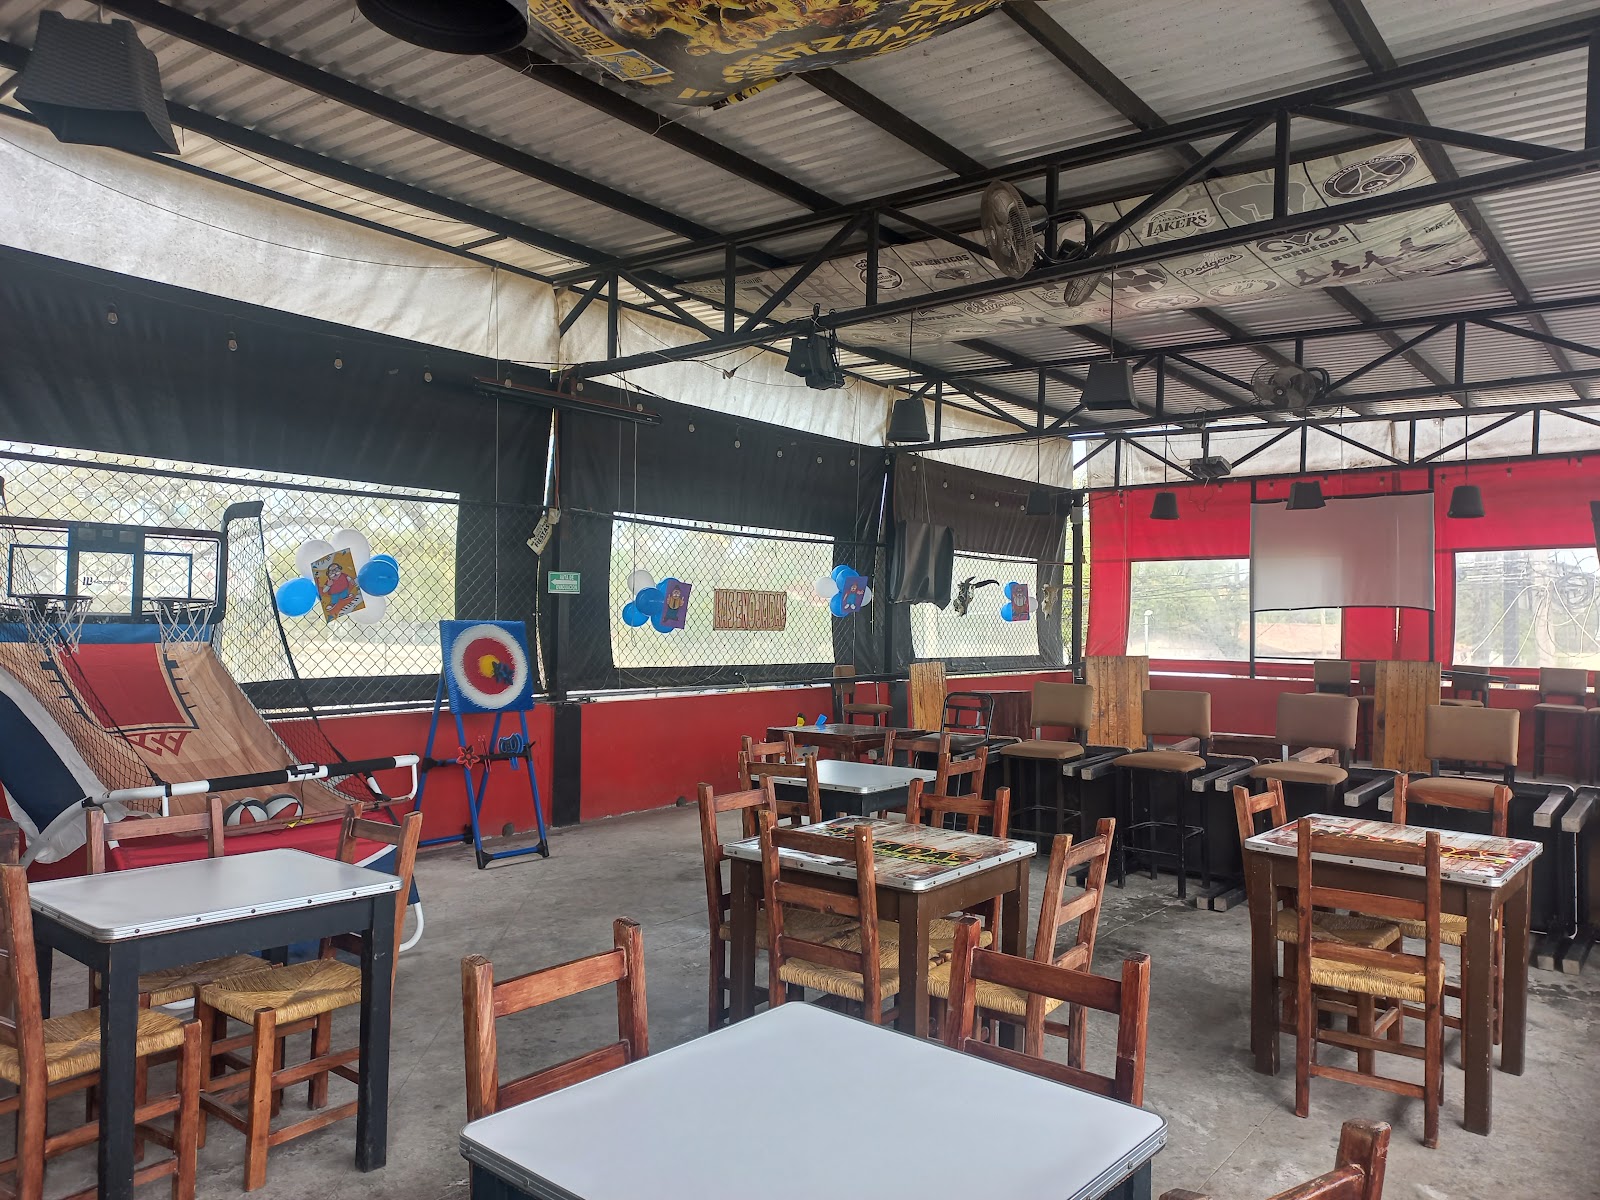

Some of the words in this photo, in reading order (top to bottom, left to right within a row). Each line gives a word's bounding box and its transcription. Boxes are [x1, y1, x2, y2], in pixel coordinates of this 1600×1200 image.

[1146, 213, 1208, 238] LAKERS
[1271, 235, 1349, 261] BORREGOS
[1175, 253, 1244, 277] Dodgers
